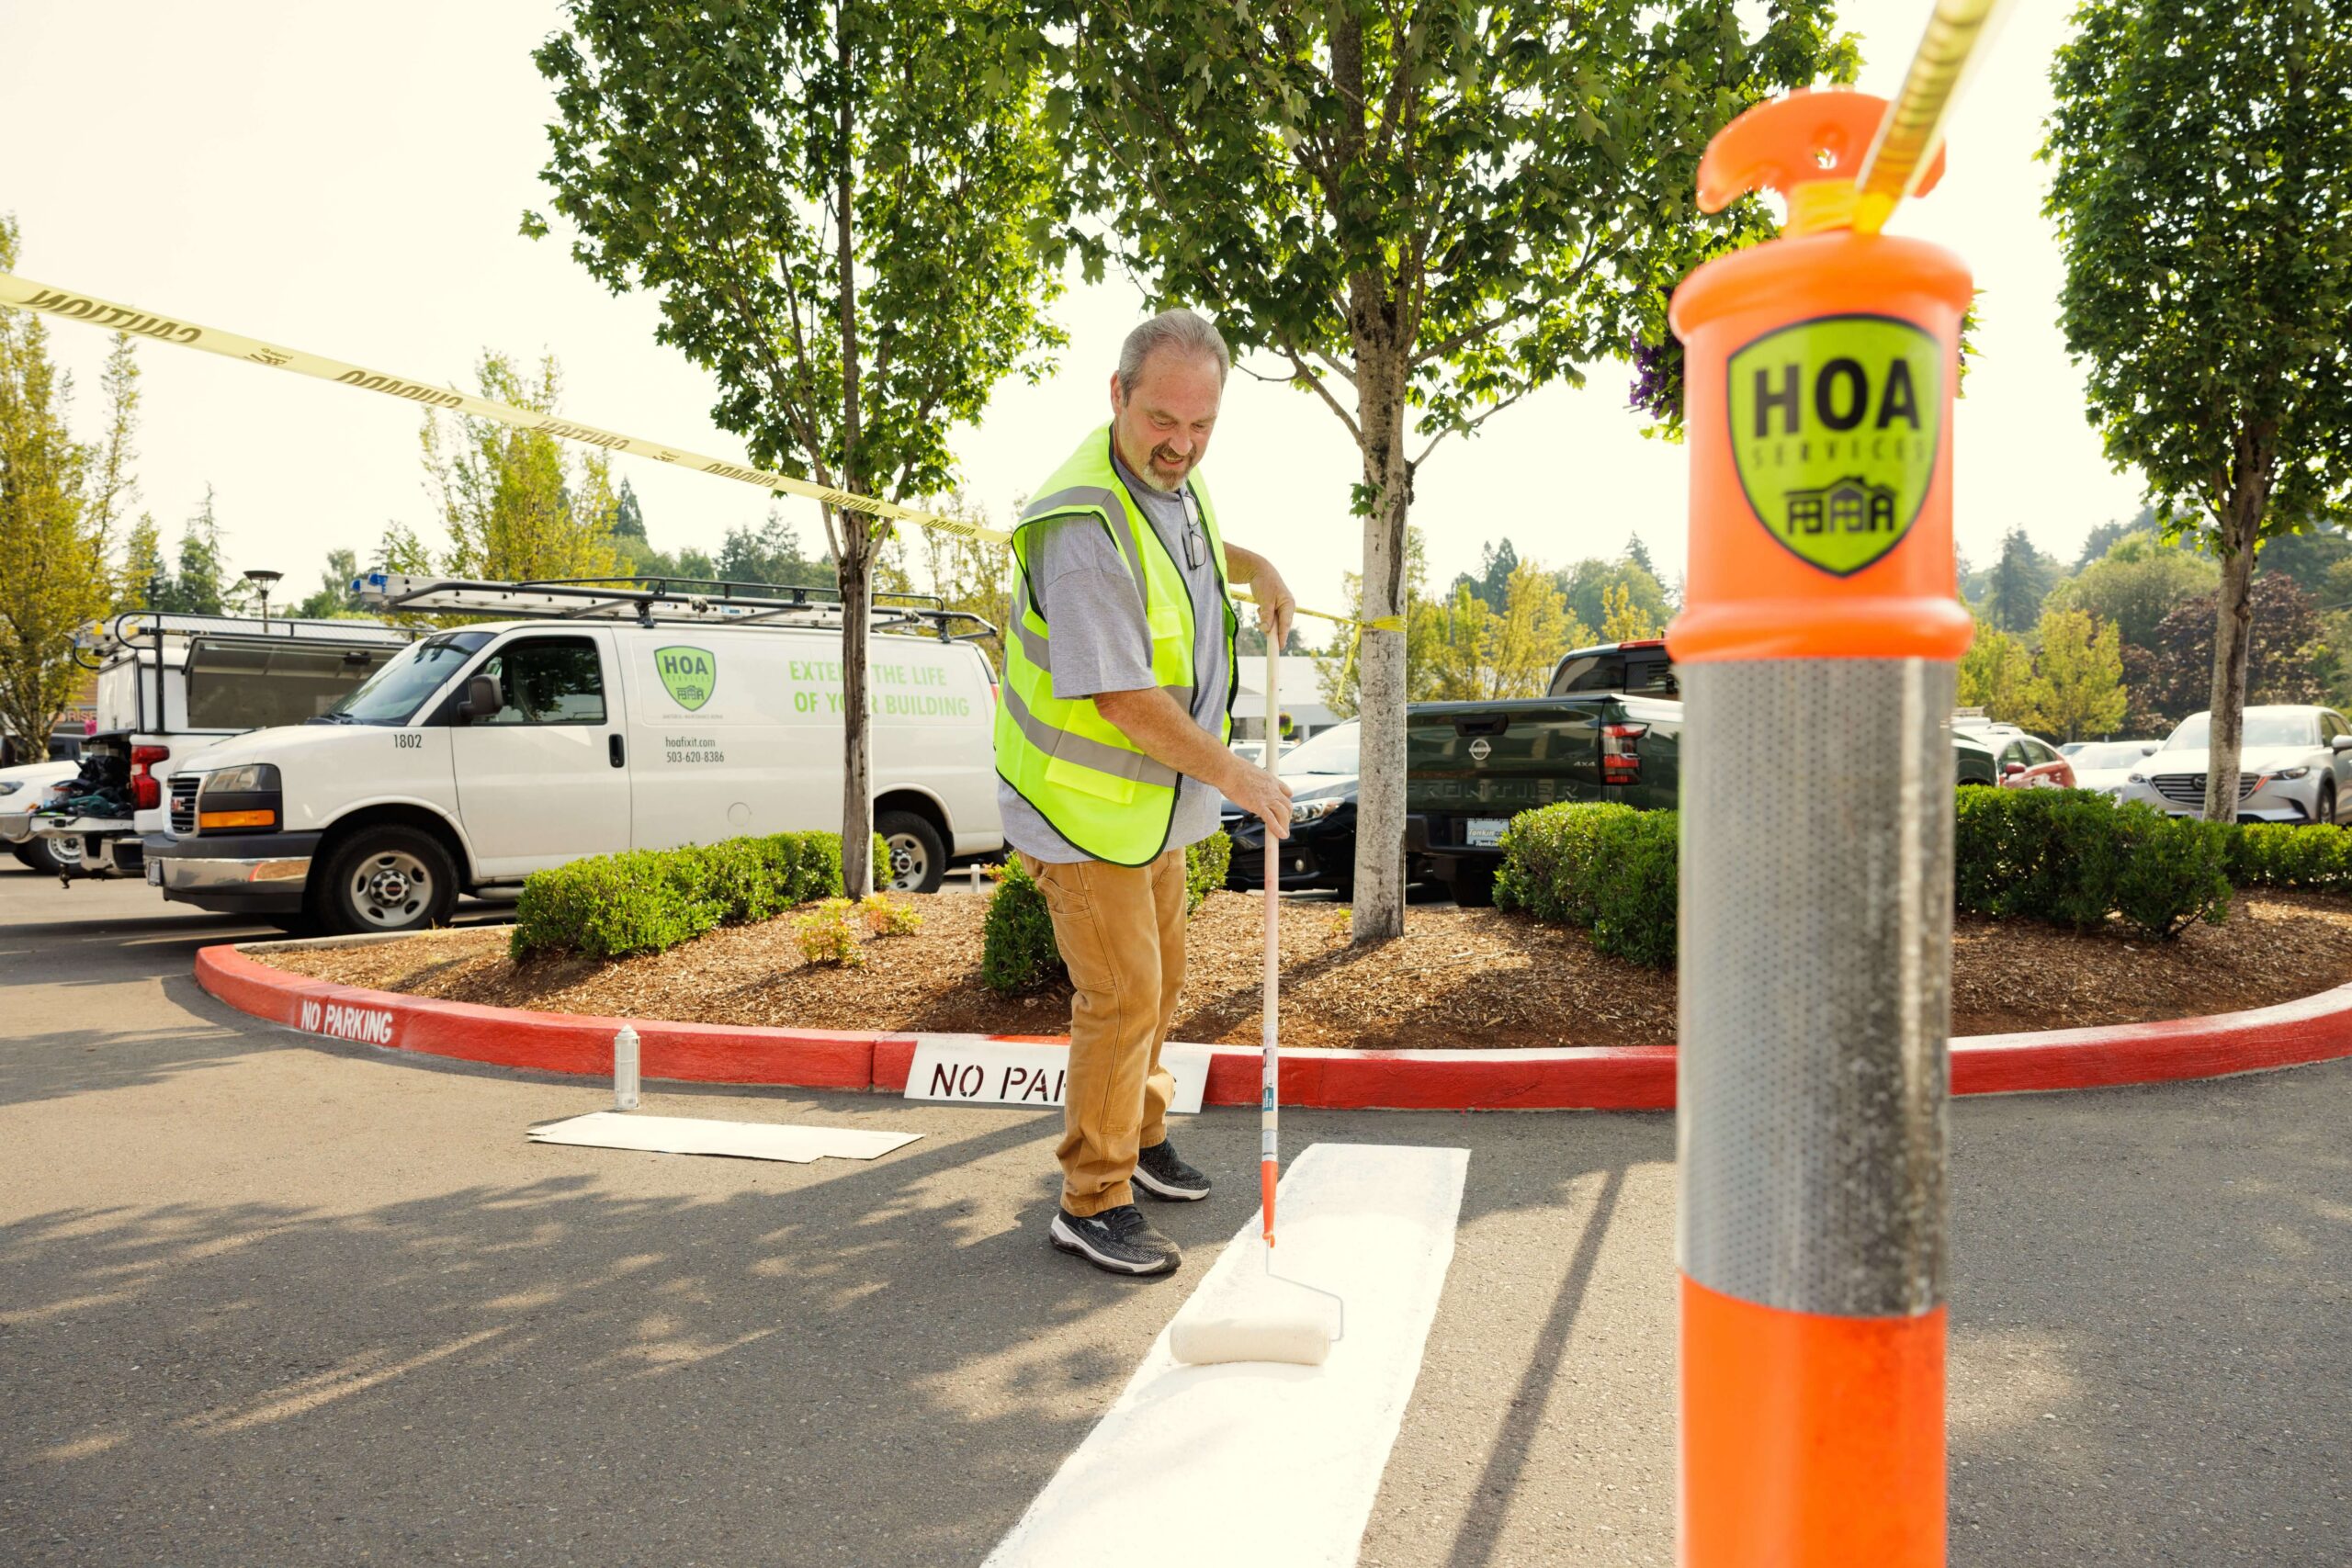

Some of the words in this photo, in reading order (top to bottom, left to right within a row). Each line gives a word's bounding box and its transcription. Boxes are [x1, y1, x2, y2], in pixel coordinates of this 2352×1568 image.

[1755, 356, 1919, 438] HOA
[1752, 438, 1926, 468] SERVICES
[663, 655, 709, 675] HOA
[789, 660, 843, 682] EXTE
[871, 664, 907, 684] THE
[911, 667, 947, 686] LIFE
[794, 692, 819, 713] OF
[825, 692, 878, 714] YR
[885, 695, 970, 716] BUILDING
[394, 734, 422, 749] 1802
[665, 737, 716, 748] hoafixit.com
[666, 751, 725, 763] 503-620-8386
[300, 999, 321, 1032] NO
[323, 1004, 393, 1043] PARKING
[930, 1063, 984, 1098] NO
